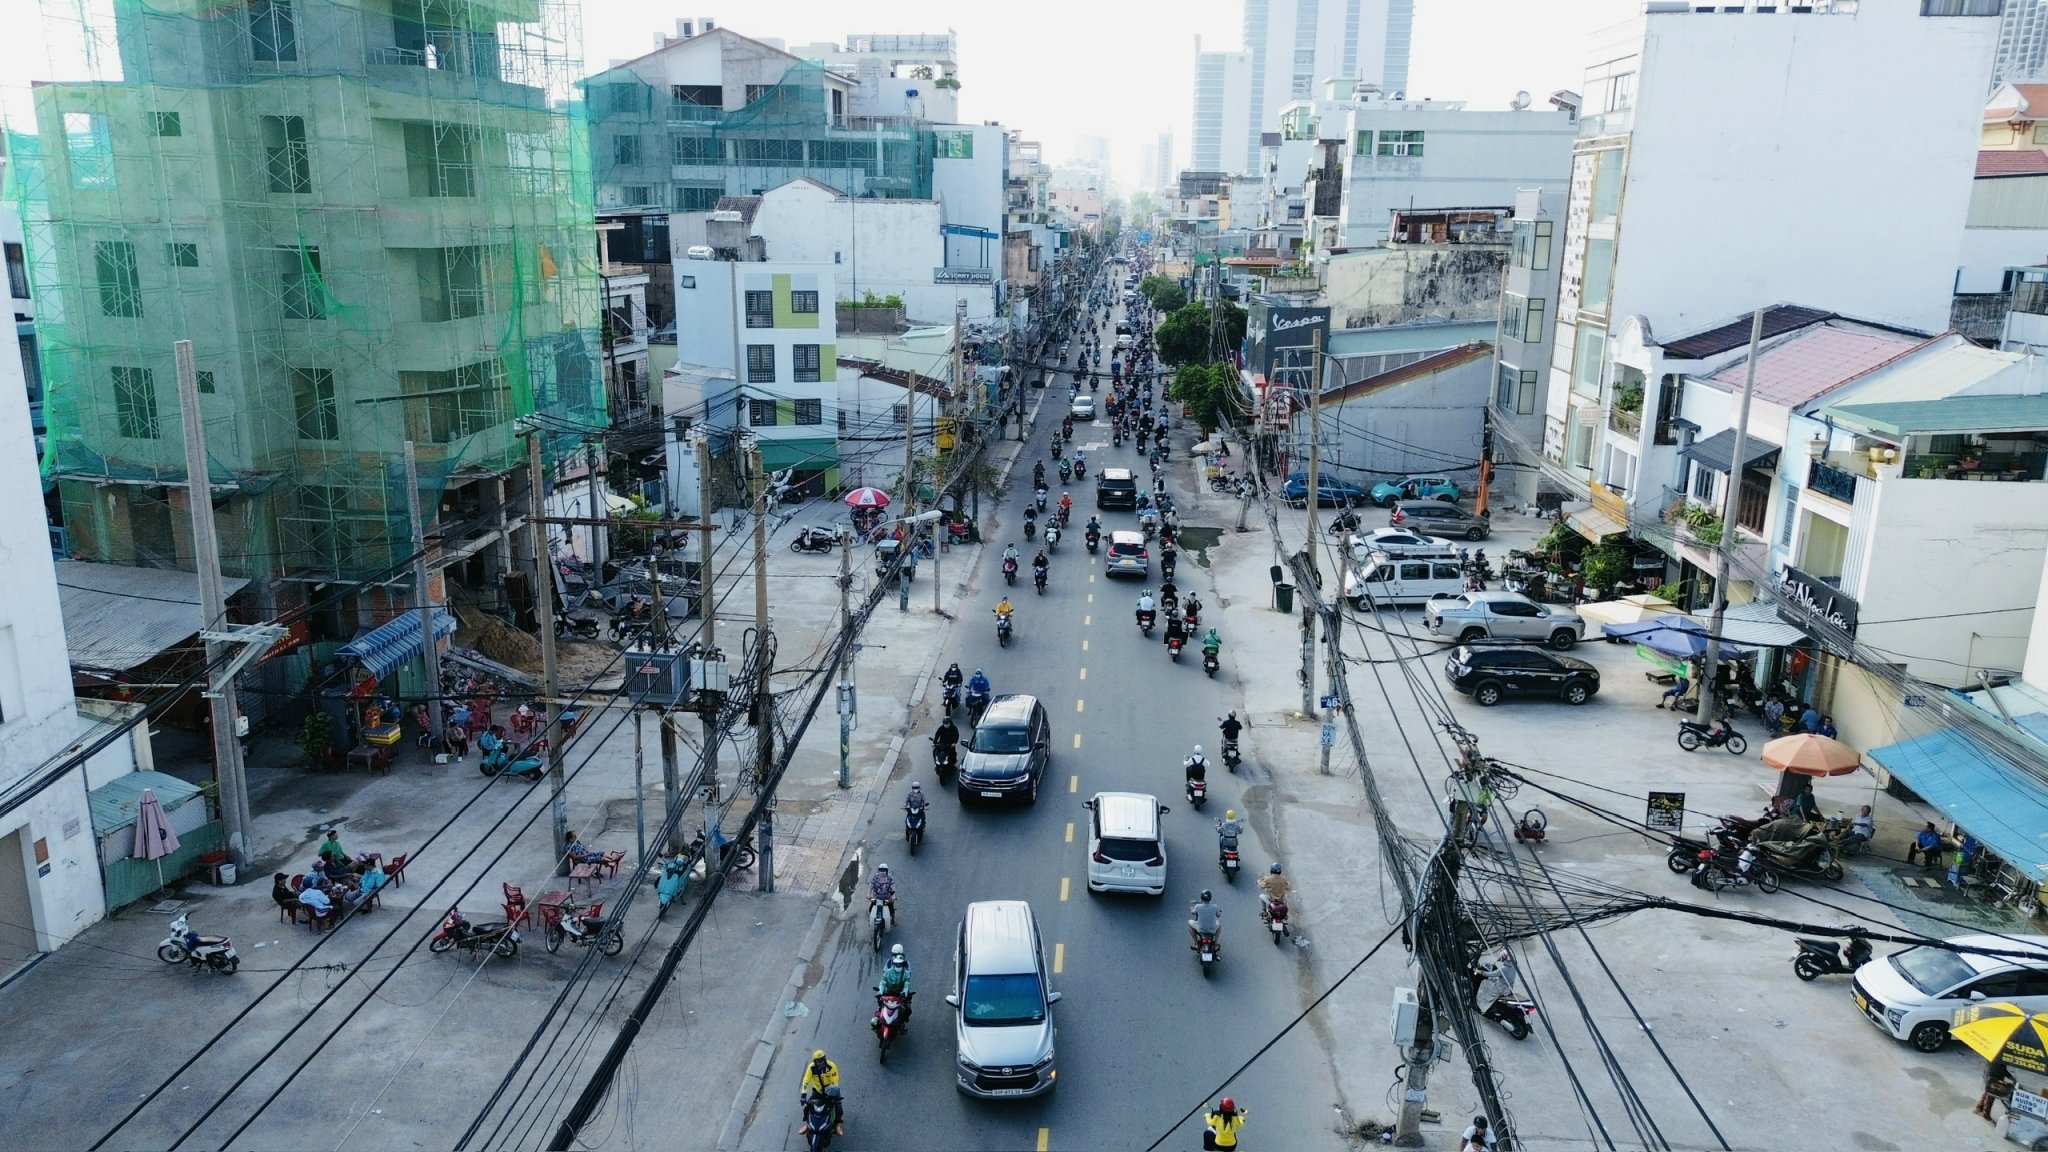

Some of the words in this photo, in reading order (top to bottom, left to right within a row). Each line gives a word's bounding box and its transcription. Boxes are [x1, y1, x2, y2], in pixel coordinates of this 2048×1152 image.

[1273, 313, 1325, 331] Vespa
[2006, 1040, 2045, 1058] SUDA
[2017, 1103, 2033, 1113] 20K
